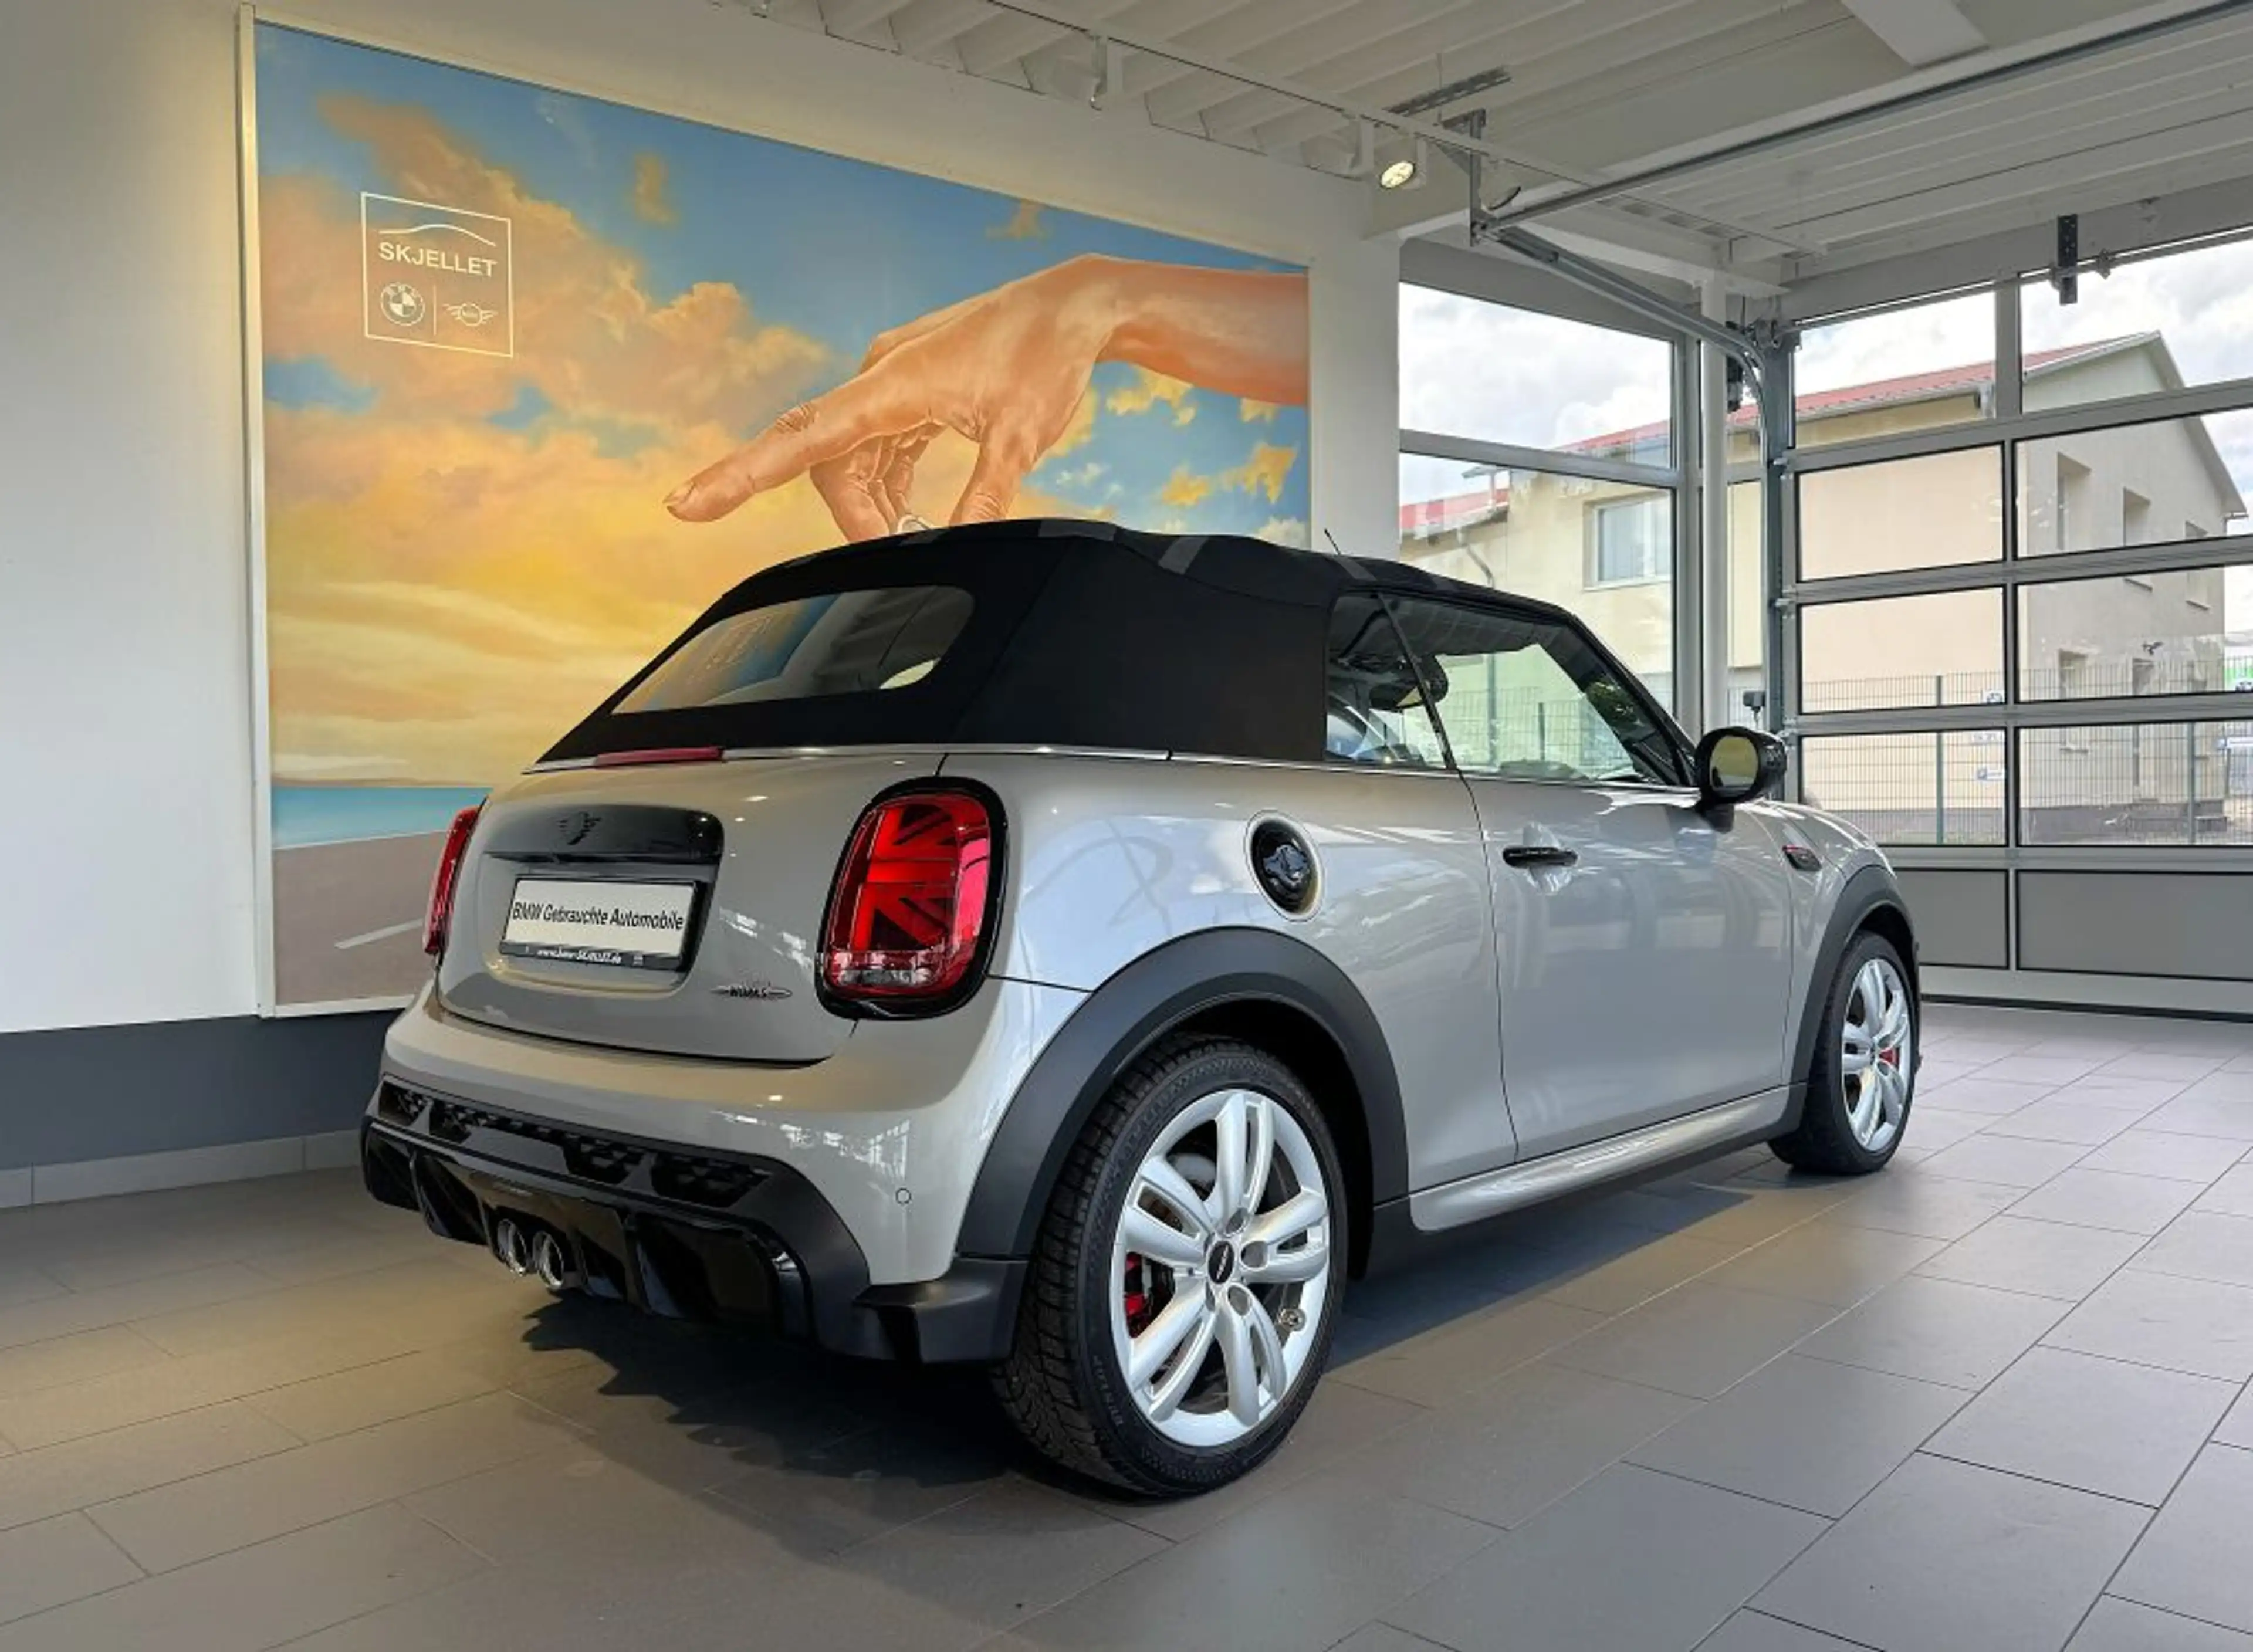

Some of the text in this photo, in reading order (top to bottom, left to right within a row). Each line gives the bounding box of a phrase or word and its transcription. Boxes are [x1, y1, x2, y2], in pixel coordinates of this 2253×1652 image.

[378, 242, 498, 276] SKJELLET
[513, 902, 683, 930] BMW Gebrauchte Automobile
